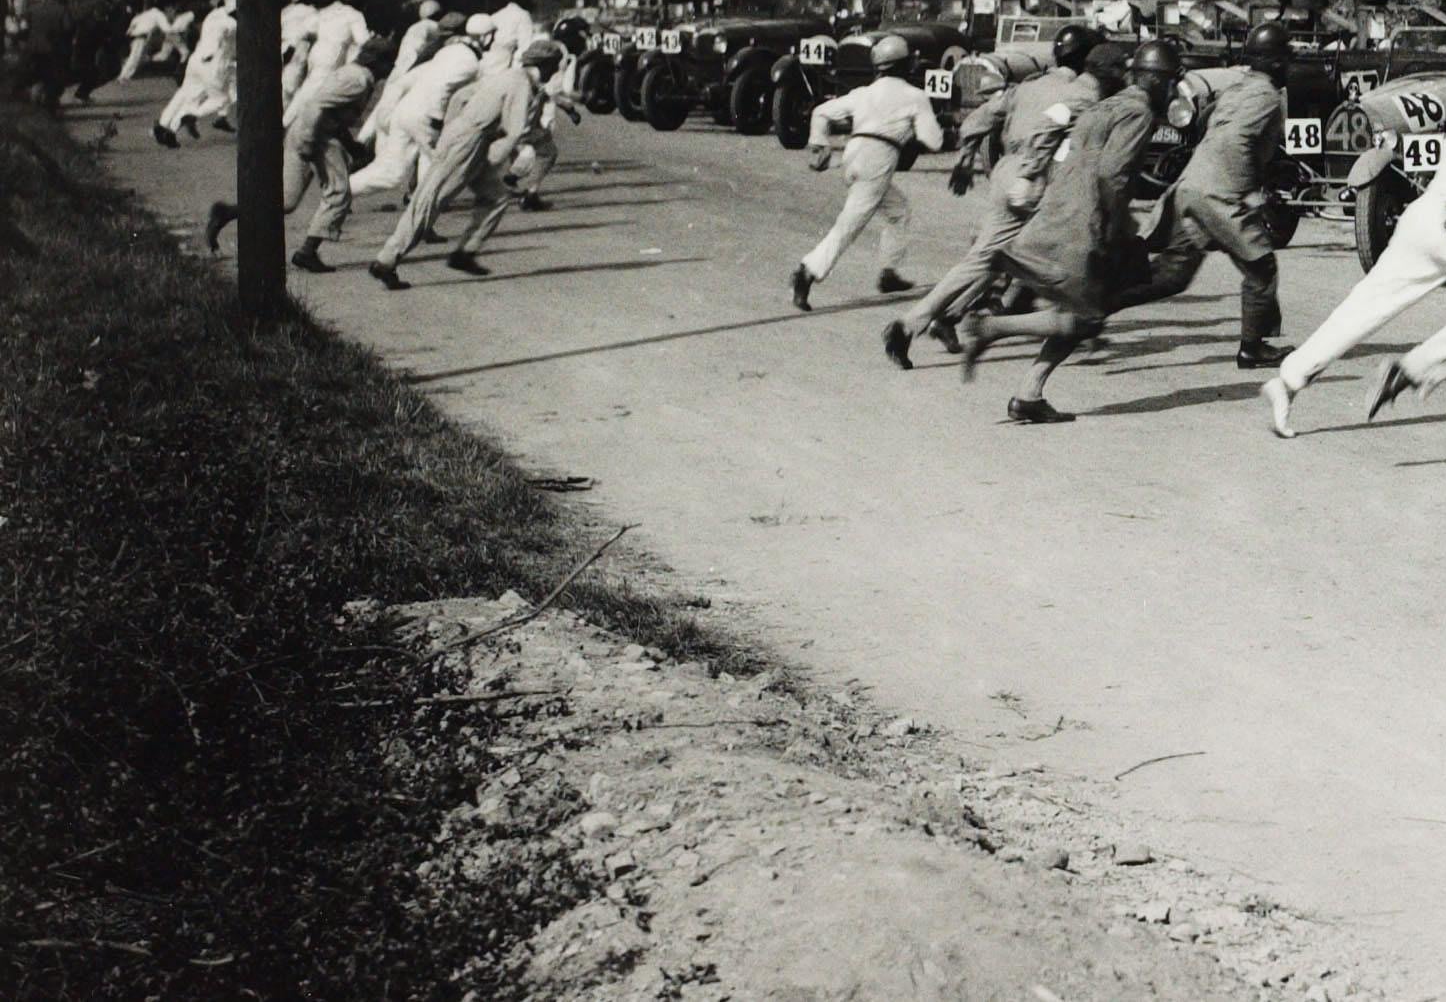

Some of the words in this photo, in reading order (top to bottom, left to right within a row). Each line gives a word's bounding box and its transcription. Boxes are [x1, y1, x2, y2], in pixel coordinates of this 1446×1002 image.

[801, 44, 823, 59] 44
[927, 74, 950, 93] 45
[1288, 124, 1320, 148] 48
[1325, 111, 1373, 151] 48
[1405, 139, 1441, 166] 49
